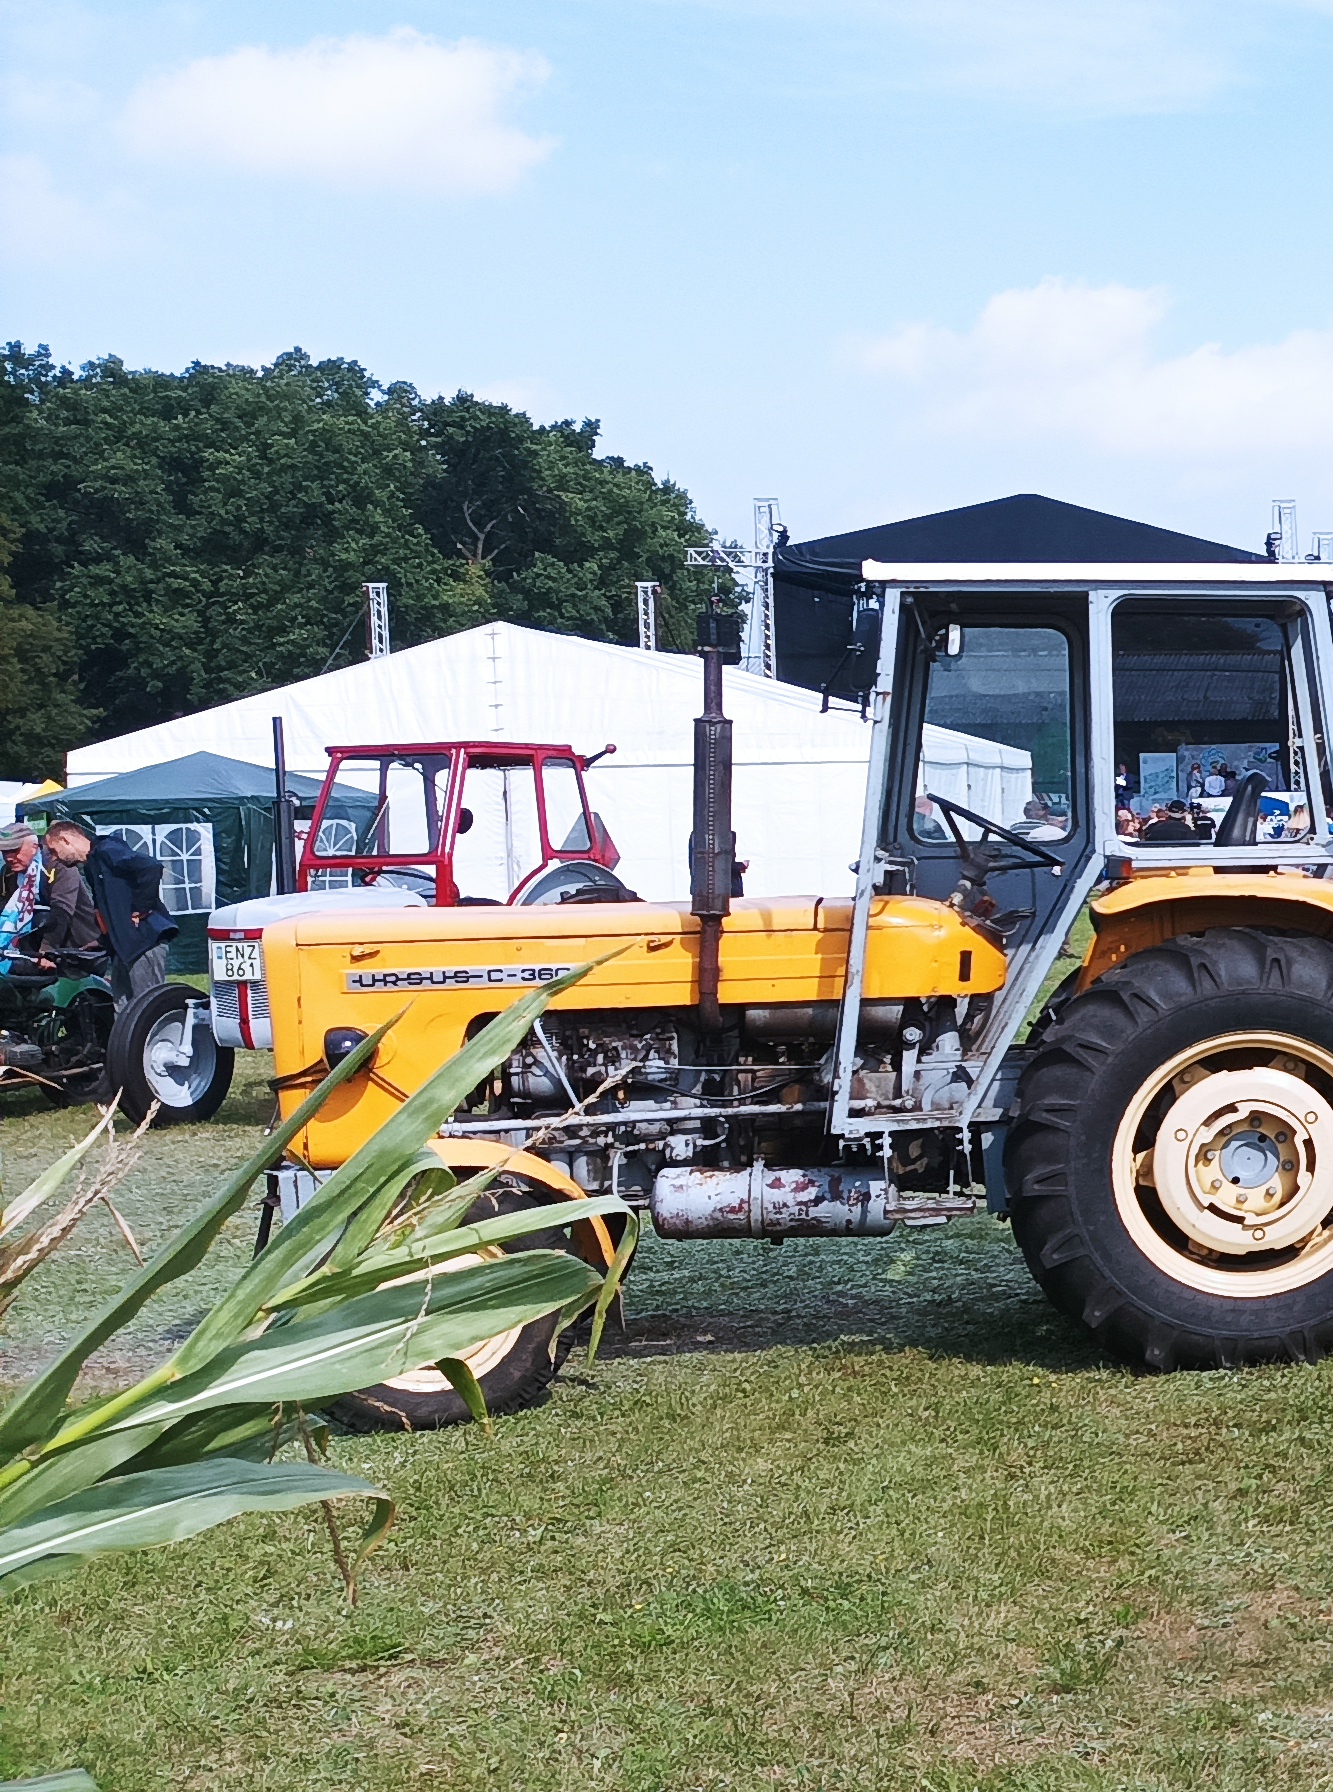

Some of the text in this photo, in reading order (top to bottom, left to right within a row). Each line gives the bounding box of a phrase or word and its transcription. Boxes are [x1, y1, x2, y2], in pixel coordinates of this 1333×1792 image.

[225, 945, 257, 960] ENZ
[226, 962, 254, 977] 861
[352, 970, 483, 987] URSUS
